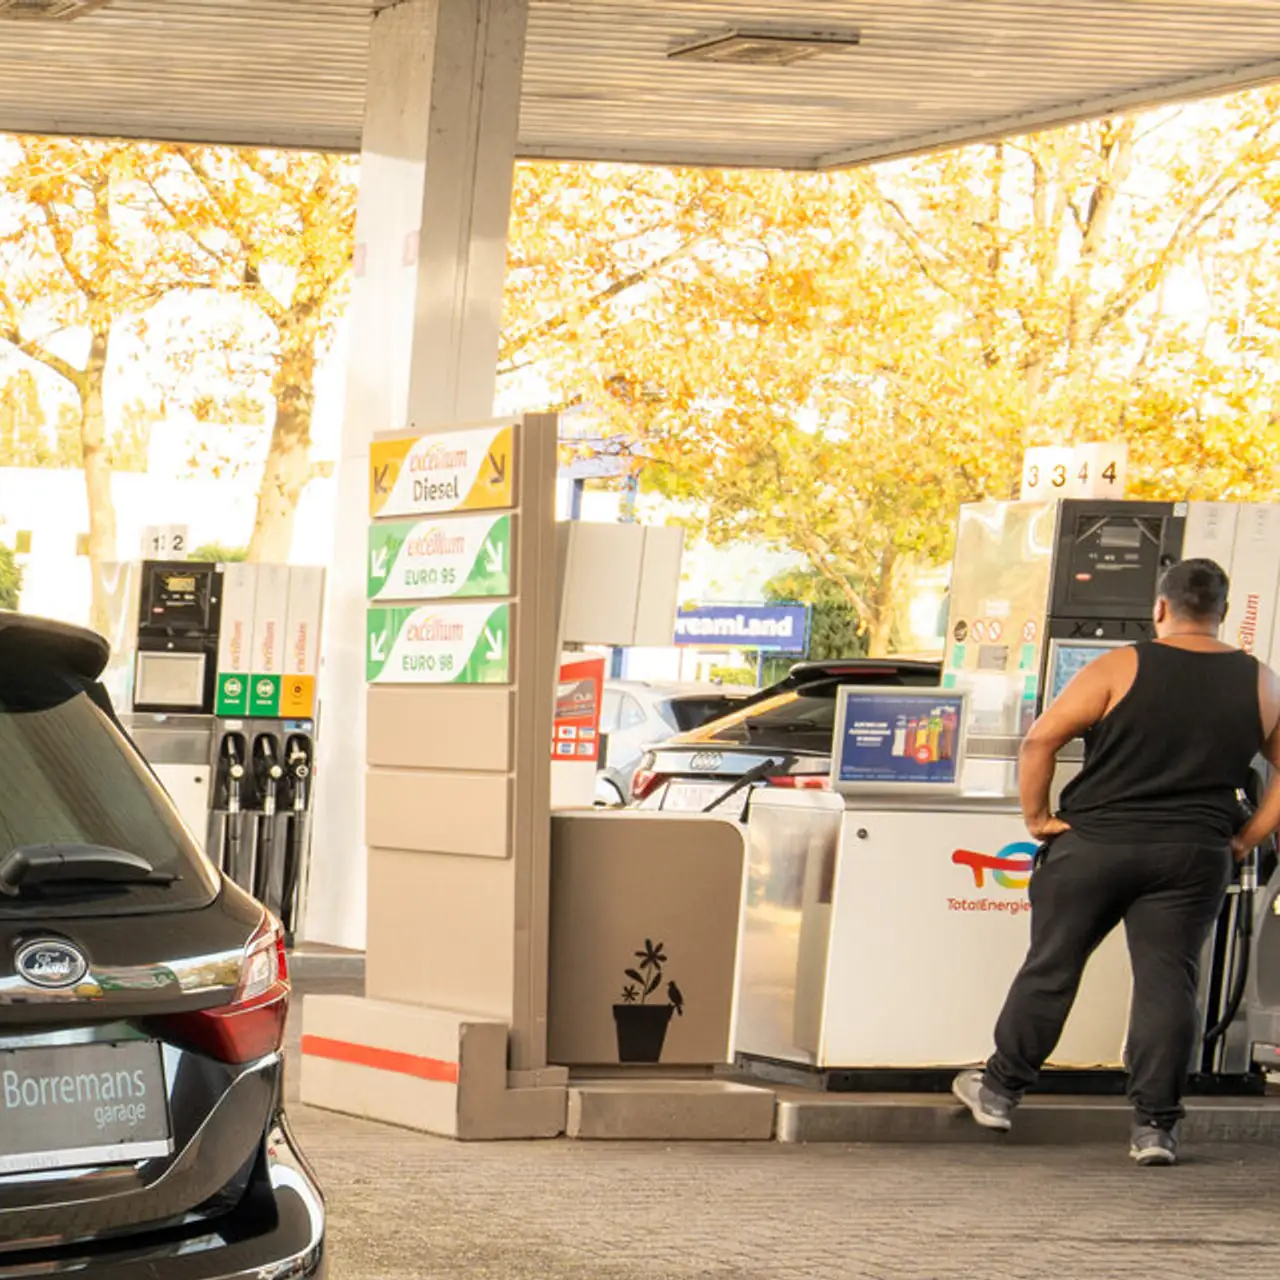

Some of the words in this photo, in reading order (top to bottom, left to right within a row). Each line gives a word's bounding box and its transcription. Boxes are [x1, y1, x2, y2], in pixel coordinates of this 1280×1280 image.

[1052, 465, 1066, 488] 3
[1077, 461, 1089, 484] 4
[1101, 461, 1117, 485] 4
[413, 475, 459, 502] Diesel
[172, 535, 184, 551] 2
[404, 569, 438, 586] EURO
[441, 567, 456, 584] 95
[677, 614, 794, 637] reamLand
[1239, 593, 1260, 655] ellium
[402, 654, 436, 671] EURO
[947, 898, 1032, 915] TotalEnergie
[26, 951, 72, 975] Ford
[2, 1069, 146, 1109] Borremans
[93, 1101, 146, 1129] garage
